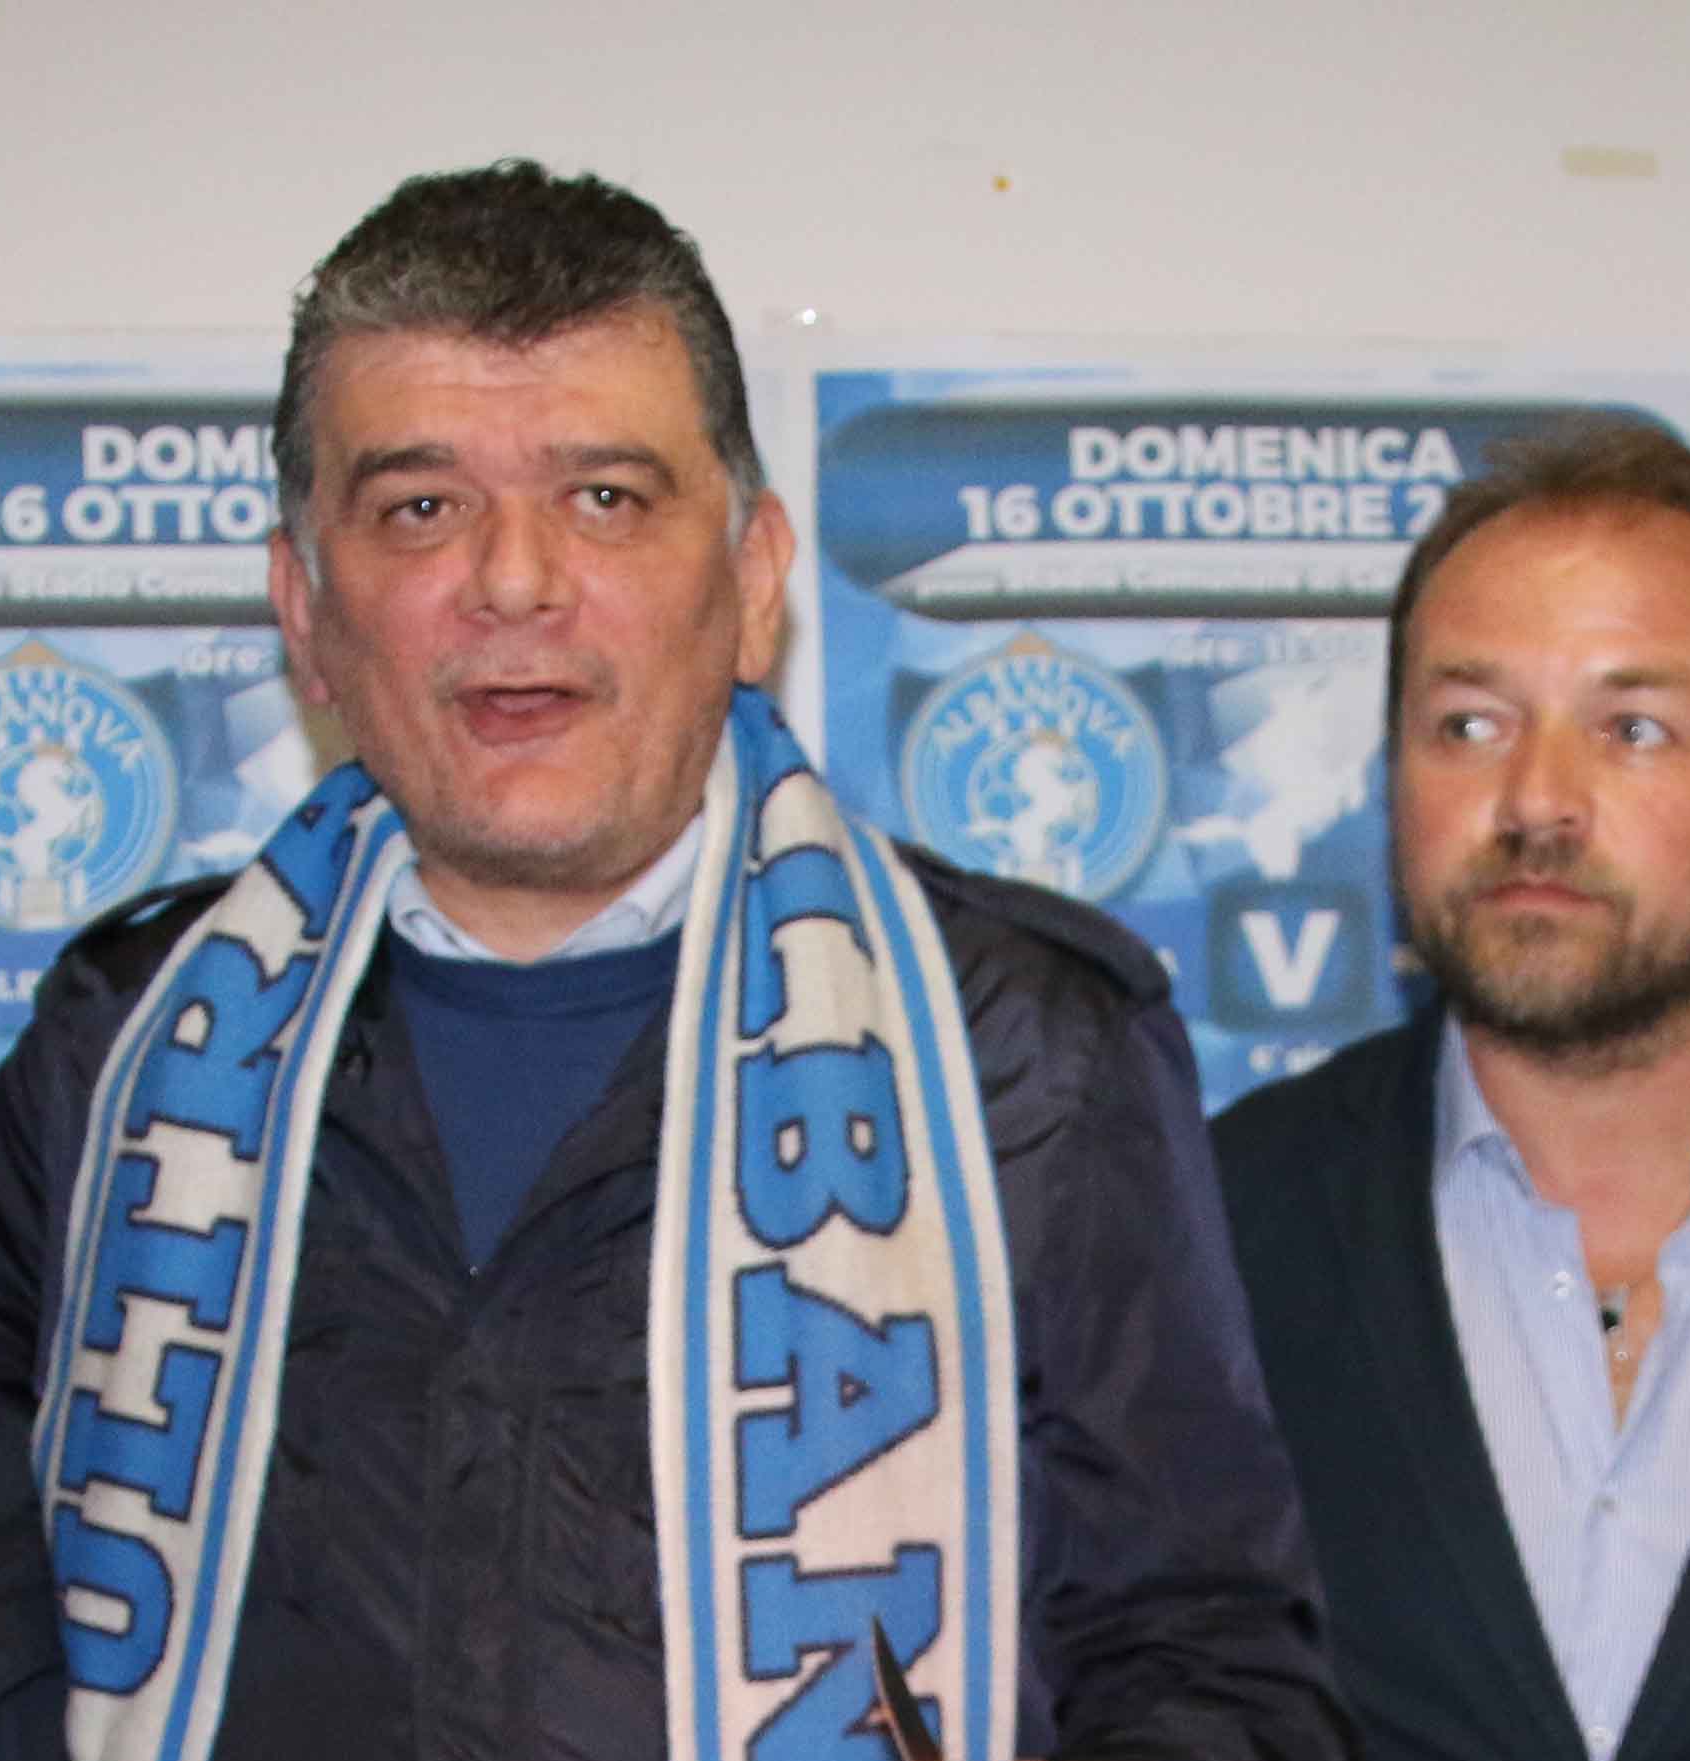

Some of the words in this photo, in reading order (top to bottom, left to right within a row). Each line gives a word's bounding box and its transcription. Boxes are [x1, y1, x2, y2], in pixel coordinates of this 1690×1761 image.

[1069, 427, 1463, 480] DOMENICA
[61, 486, 278, 542] OTTO
[958, 486, 1039, 537] 16
[1052, 485, 1395, 536] OTTOBRE
[1240, 909, 1340, 1008] V
